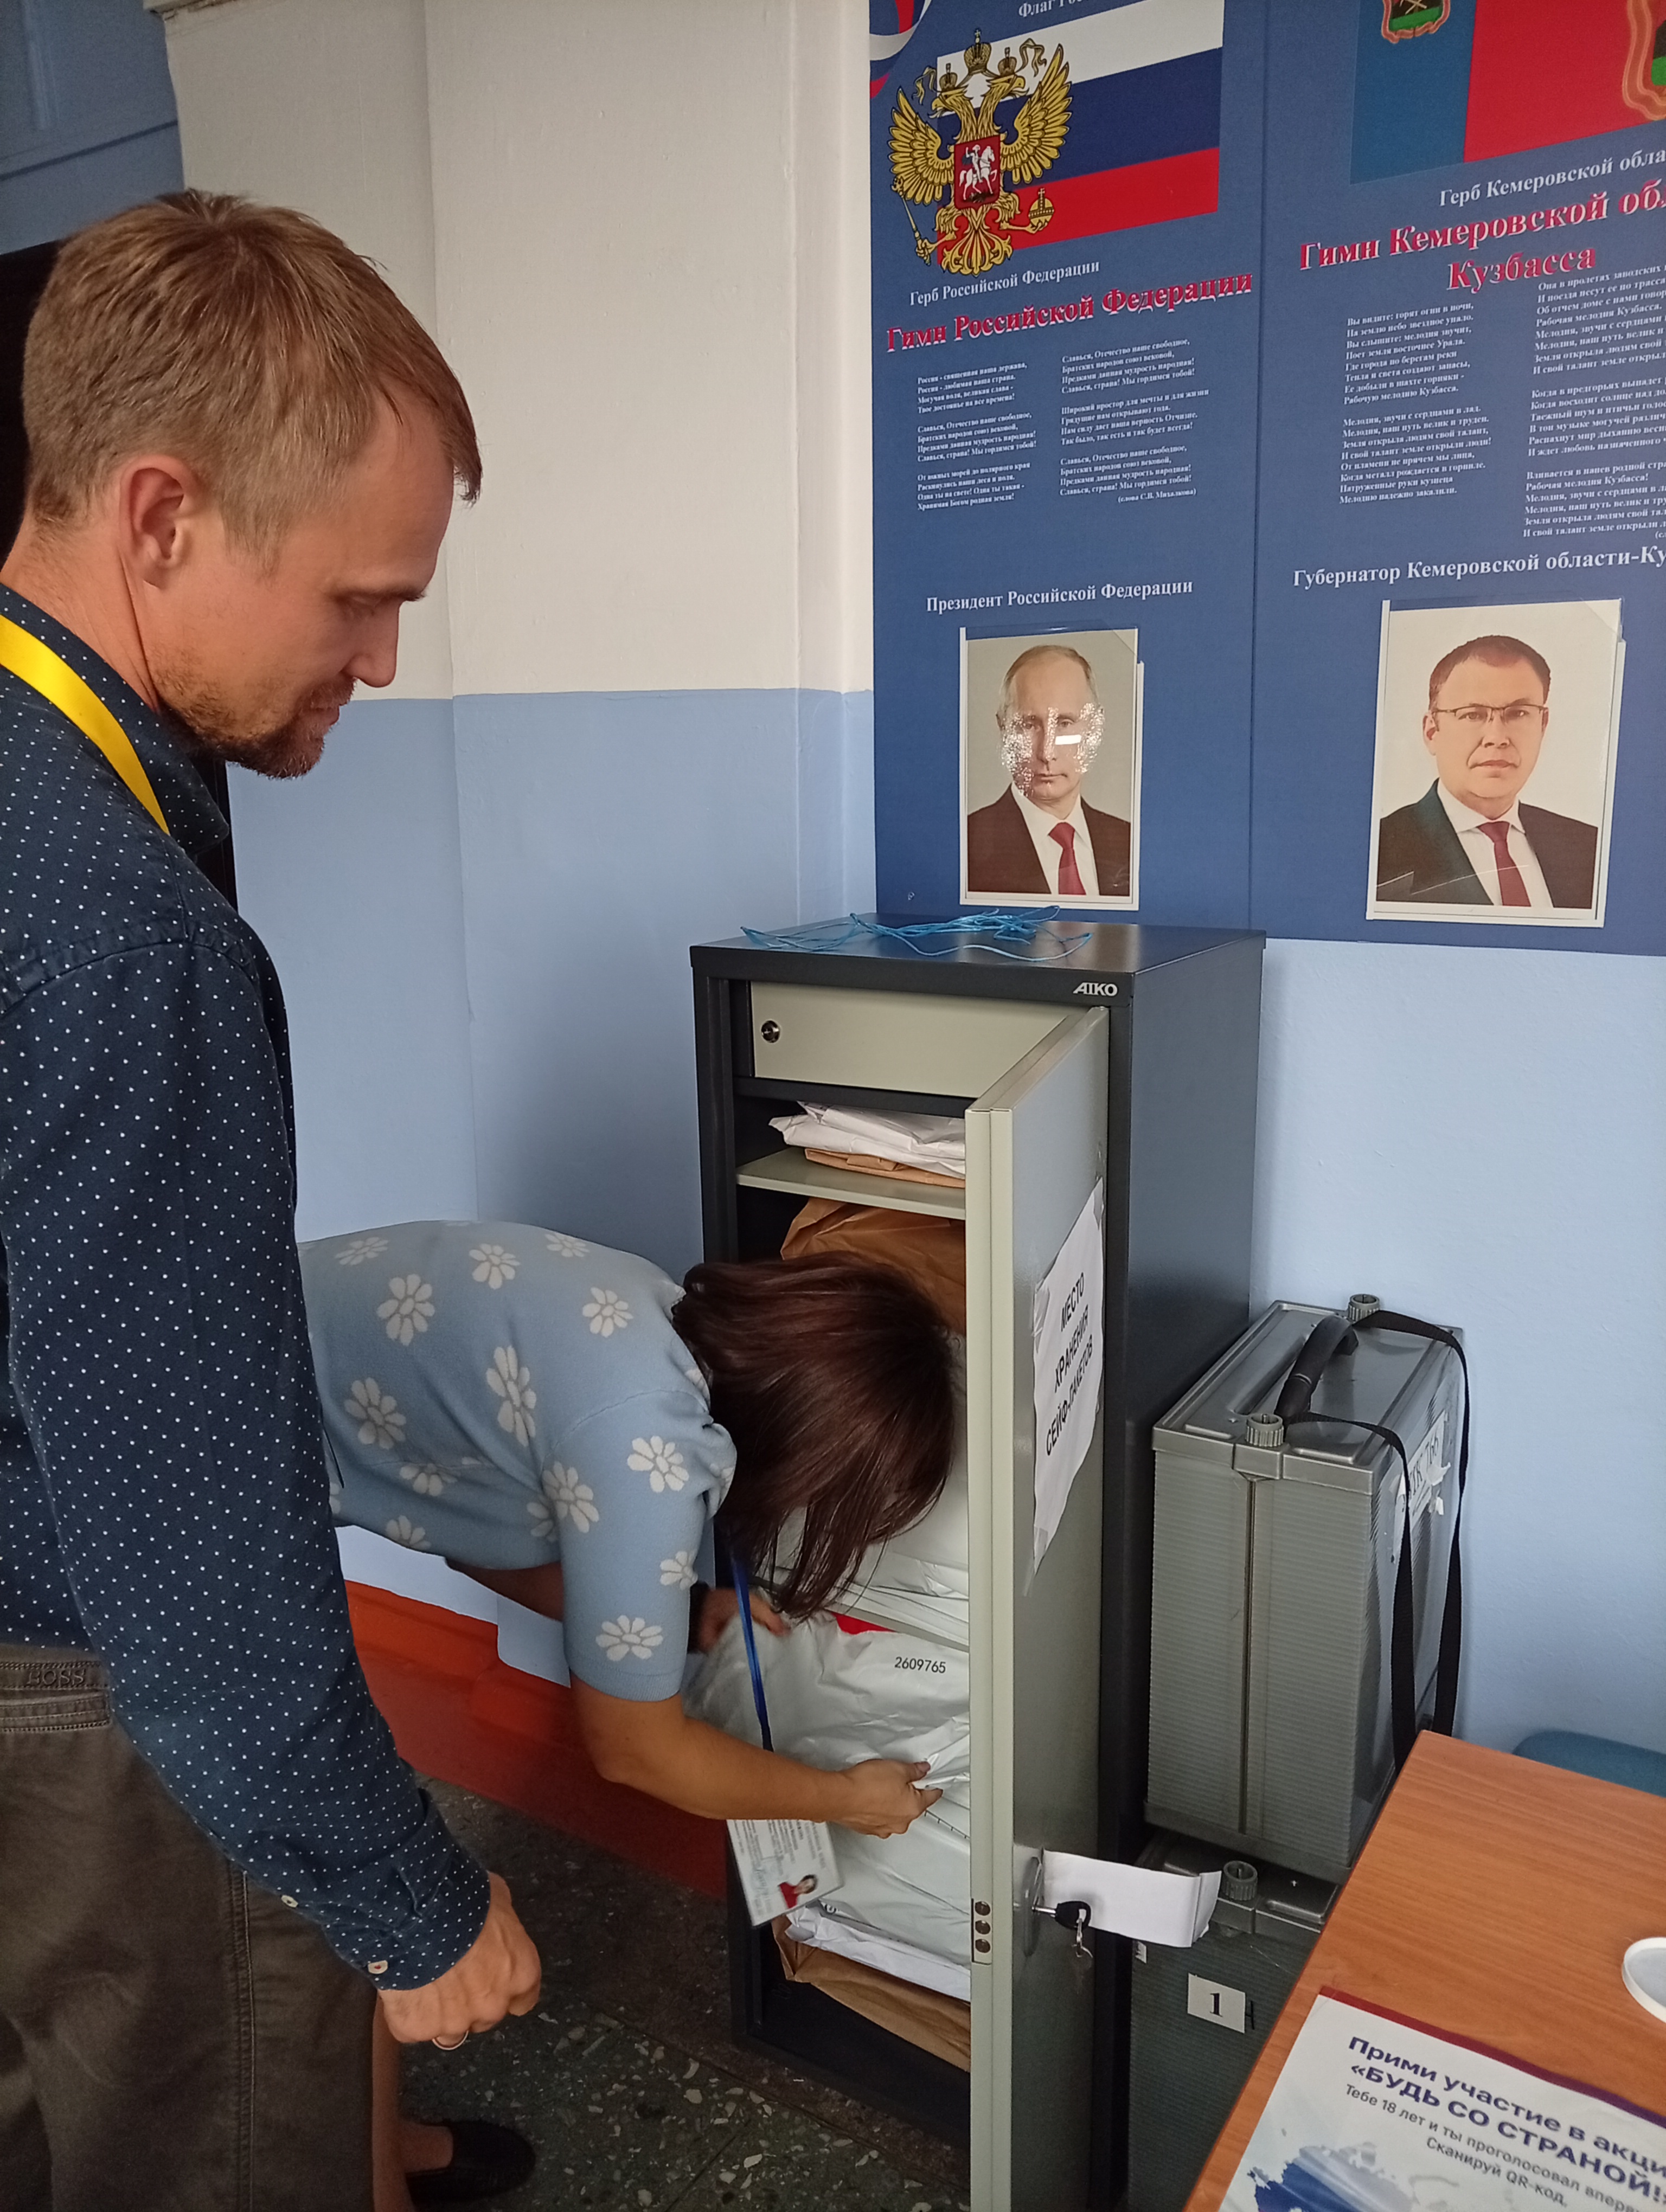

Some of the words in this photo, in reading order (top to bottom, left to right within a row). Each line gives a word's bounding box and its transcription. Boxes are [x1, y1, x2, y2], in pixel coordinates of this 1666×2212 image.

[1018, 0, 1055, 17] Флаг
[1439, 183, 1482, 207] Герб
[1486, 157, 1613, 198] Кемеровской
[1619, 150, 1666, 171] обла
[1300, 240, 1381, 271] Гимн
[1389, 191, 1610, 256] Кемеровской
[909, 287, 939, 306] Герб
[943, 274, 1018, 300] Российской
[1022, 261, 1100, 285] Федерации
[1446, 248, 1596, 294] Кузбасса
[887, 325, 946, 353] Гимн
[954, 295, 1095, 341] Российской
[1101, 273, 1253, 316] Федерации
[1293, 567, 1401, 590] Губернатор
[1407, 554, 1539, 581] Кемеровской
[1546, 545, 1666, 569] области-Ку
[926, 596, 1003, 614] Президент
[1008, 586, 1097, 606] Российской
[1101, 581, 1193, 600] Федерации
[1073, 982, 1118, 996] AIKO
[1061, 1272, 1085, 1332] МЕСТО
[1055, 1304, 1088, 1393] ХРАНЕНИЯ
[894, 1656, 946, 1674] 2609765
[1210, 1992, 1223, 2017] 1
[1348, 2036, 1437, 2082] Прими
[1444, 2075, 1561, 2132] участие
[1569, 2125, 1586, 2142] в
[1593, 2136, 1666, 2178] акци
[1351, 2065, 1440, 2107] «БУДЬ
[1447, 2100, 1490, 2127] СО
[1345, 2084, 1378, 2106] Тебе
[1382, 2099, 1397, 2114] 18
[1399, 2108, 1426, 2126] лет
[1429, 2121, 1438, 2132] и
[1443, 2126, 1463, 2143] ты
[1466, 2137, 1580, 2191] проголосовал
[1427, 2137, 1502, 2178] Сканируй
